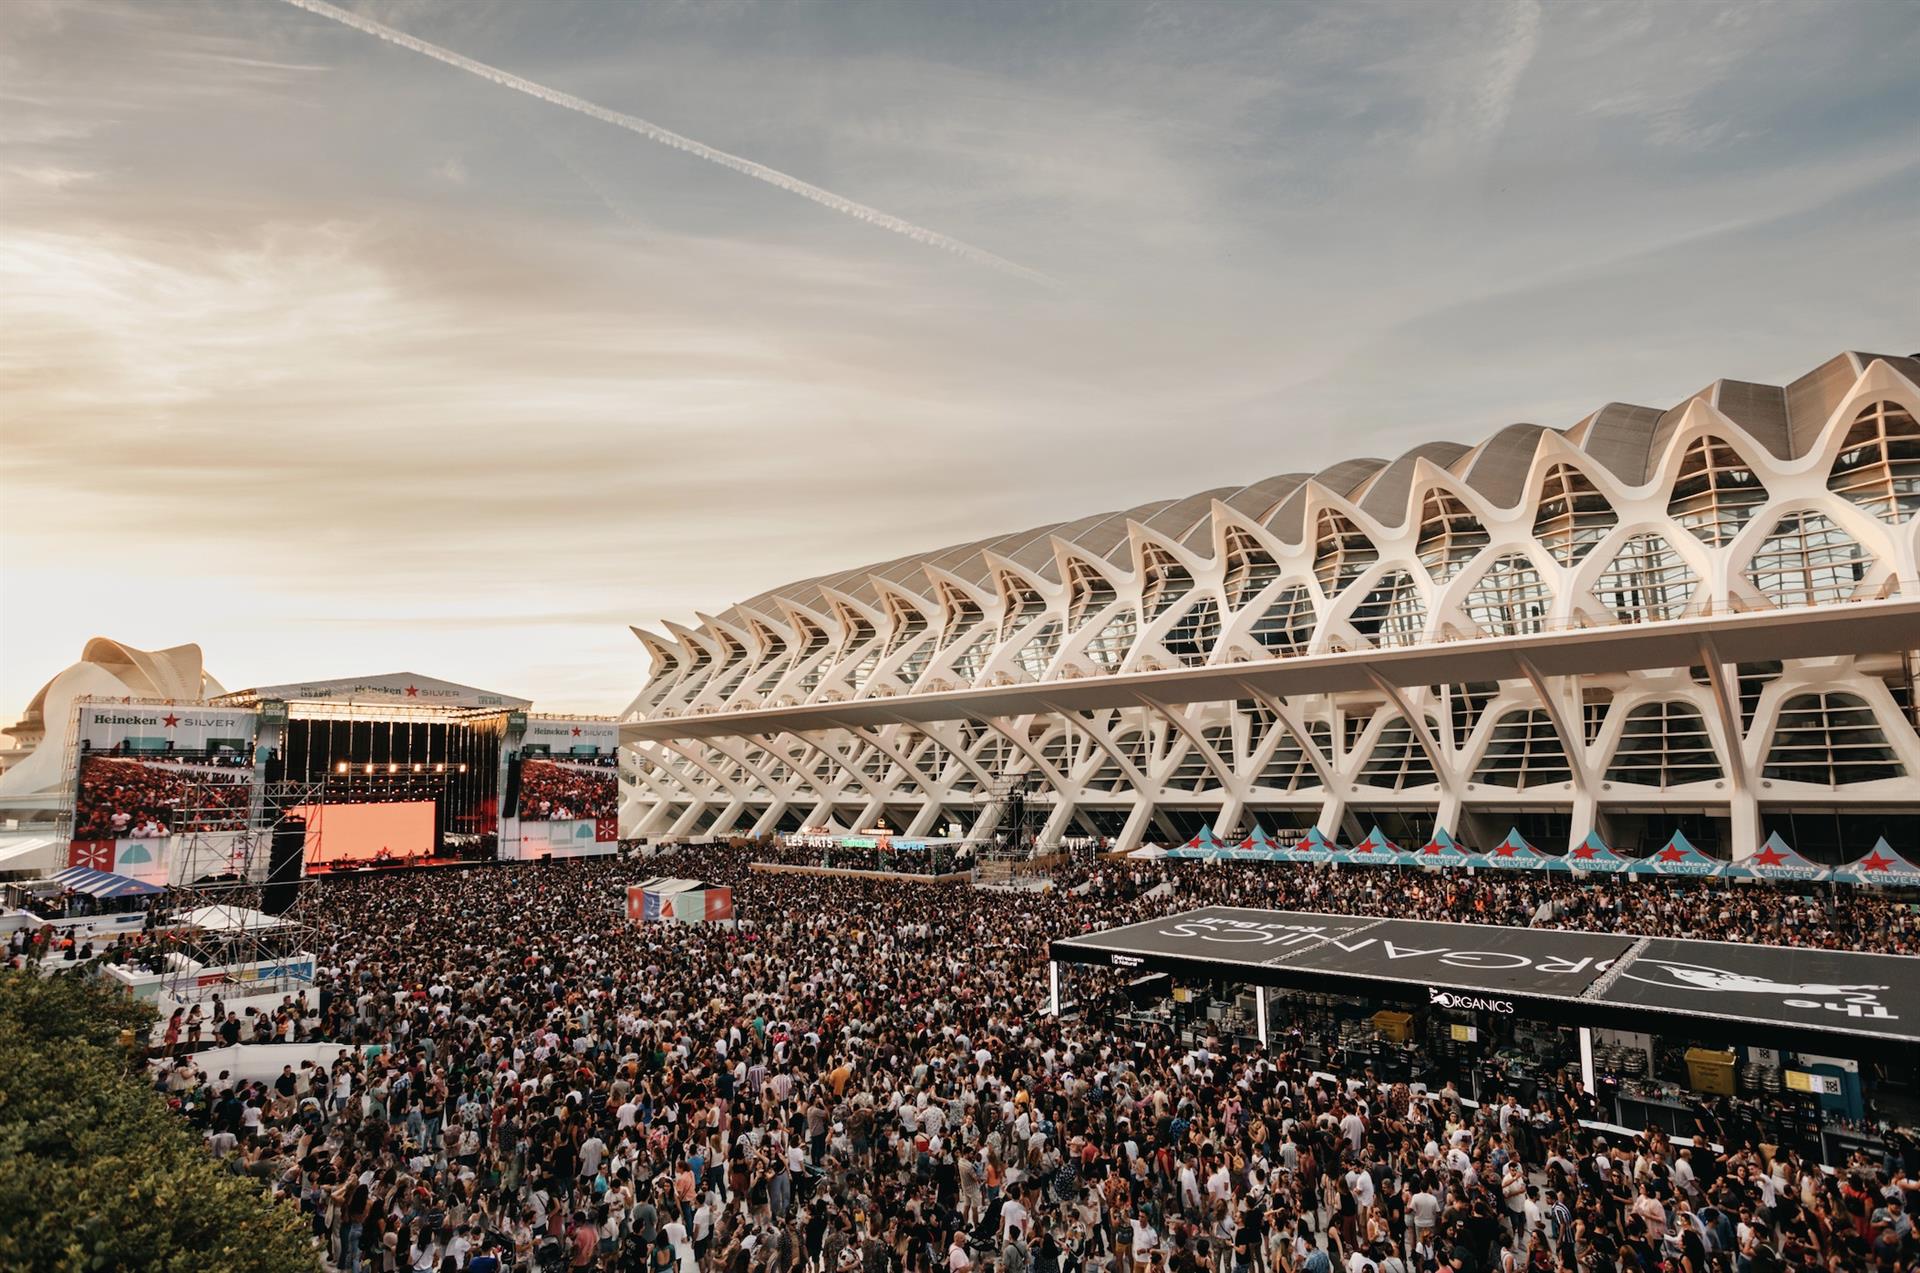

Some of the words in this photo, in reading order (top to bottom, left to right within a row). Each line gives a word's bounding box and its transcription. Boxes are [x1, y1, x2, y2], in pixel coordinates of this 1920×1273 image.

[421, 689, 460, 697] SILVER
[95, 714, 157, 725] Heineken
[184, 718, 236, 727] SILVER
[534, 727, 569, 736] Heineken
[583, 729, 614, 737] SILVER
[785, 835, 803, 847] LES
[808, 836, 834, 848] ARTS
[1068, 839, 1086, 850] VIP
[1665, 866, 1709, 874] SILVER
[1764, 869, 1813, 879] SILVER
[1871, 875, 1920, 884] SILVER
[1159, 923, 1740, 992] ORGANICS
[1440, 992, 1514, 1014] ORGANICS
[1782, 998, 1900, 1020] The
